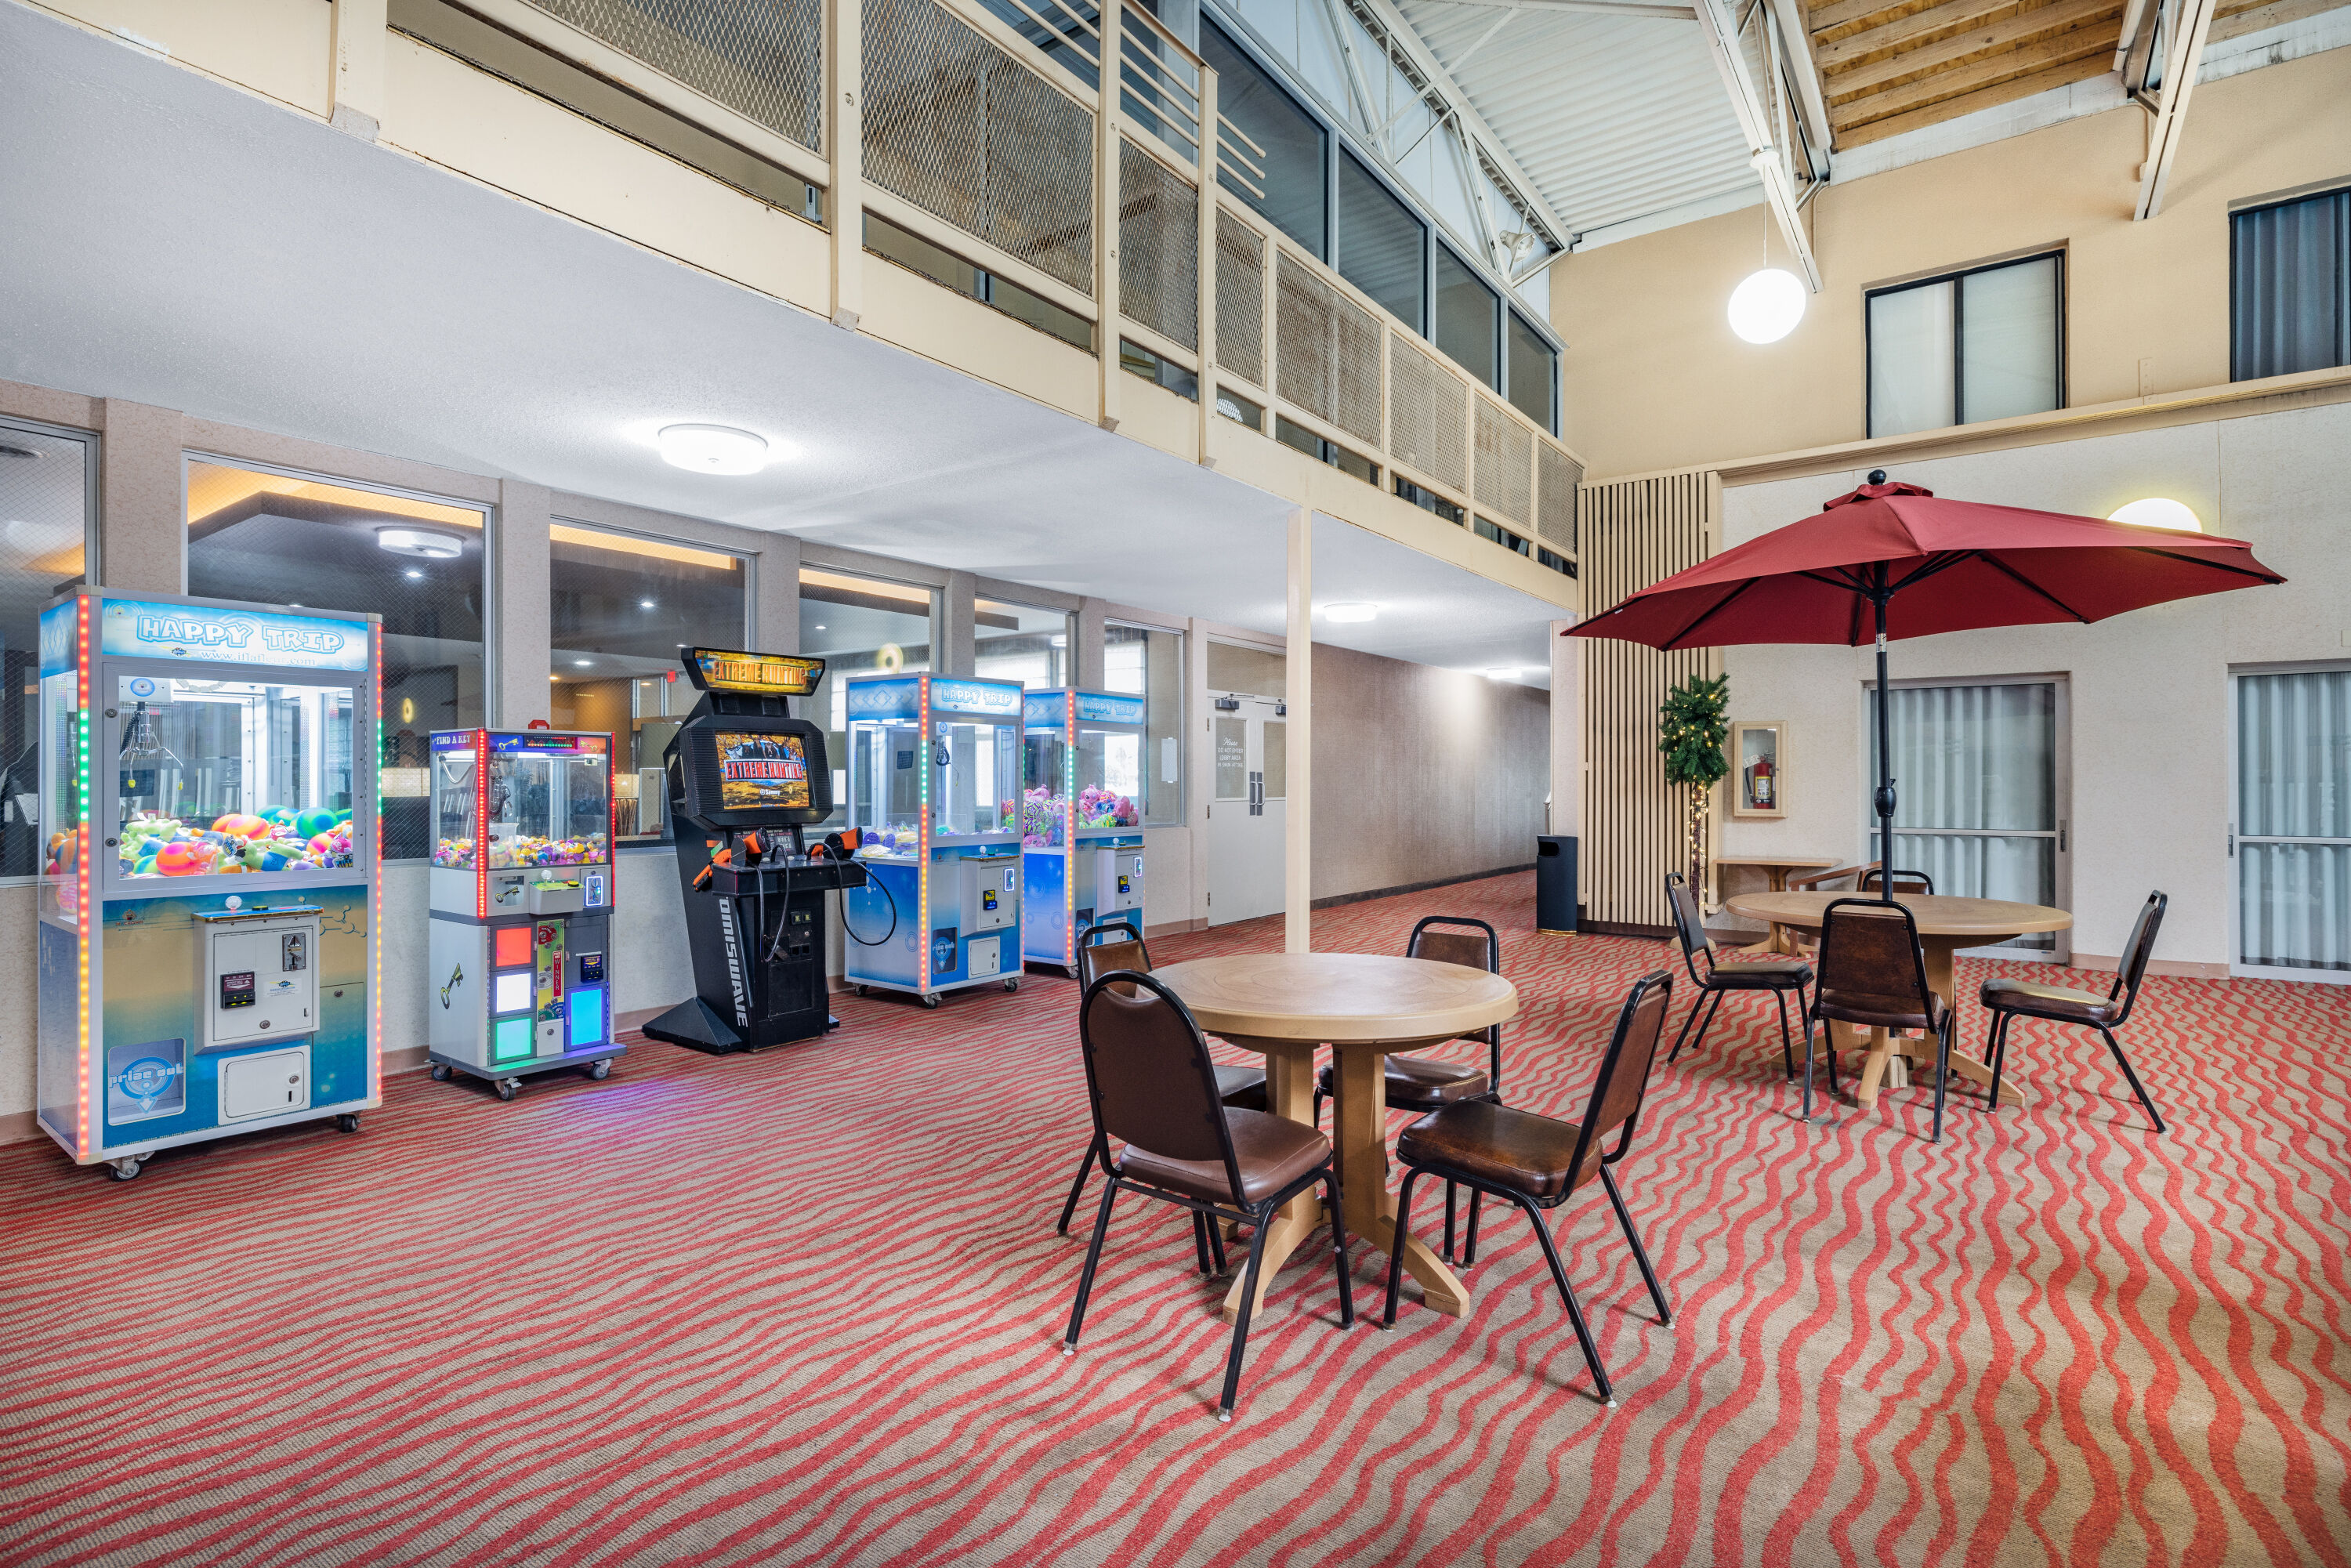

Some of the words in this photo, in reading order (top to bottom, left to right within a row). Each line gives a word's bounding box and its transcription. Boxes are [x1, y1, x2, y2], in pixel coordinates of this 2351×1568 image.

[136, 614, 253, 648] HAPPY
[261, 625, 345, 654] TRIP
[714, 661, 761, 683] EXTREME
[762, 664, 806, 685] HUNTING
[942, 687, 980, 704] HAPPY
[984, 691, 1012, 706] TRIP
[1084, 700, 1111, 714] HAPPY
[1115, 703, 1136, 716] TRIP
[458, 735, 470, 744] KEY
[726, 762, 768, 779] EXTREME
[768, 762, 802, 779] HUNTING
[109, 1070, 153, 1088] prize
[157, 1063, 184, 1077] out
